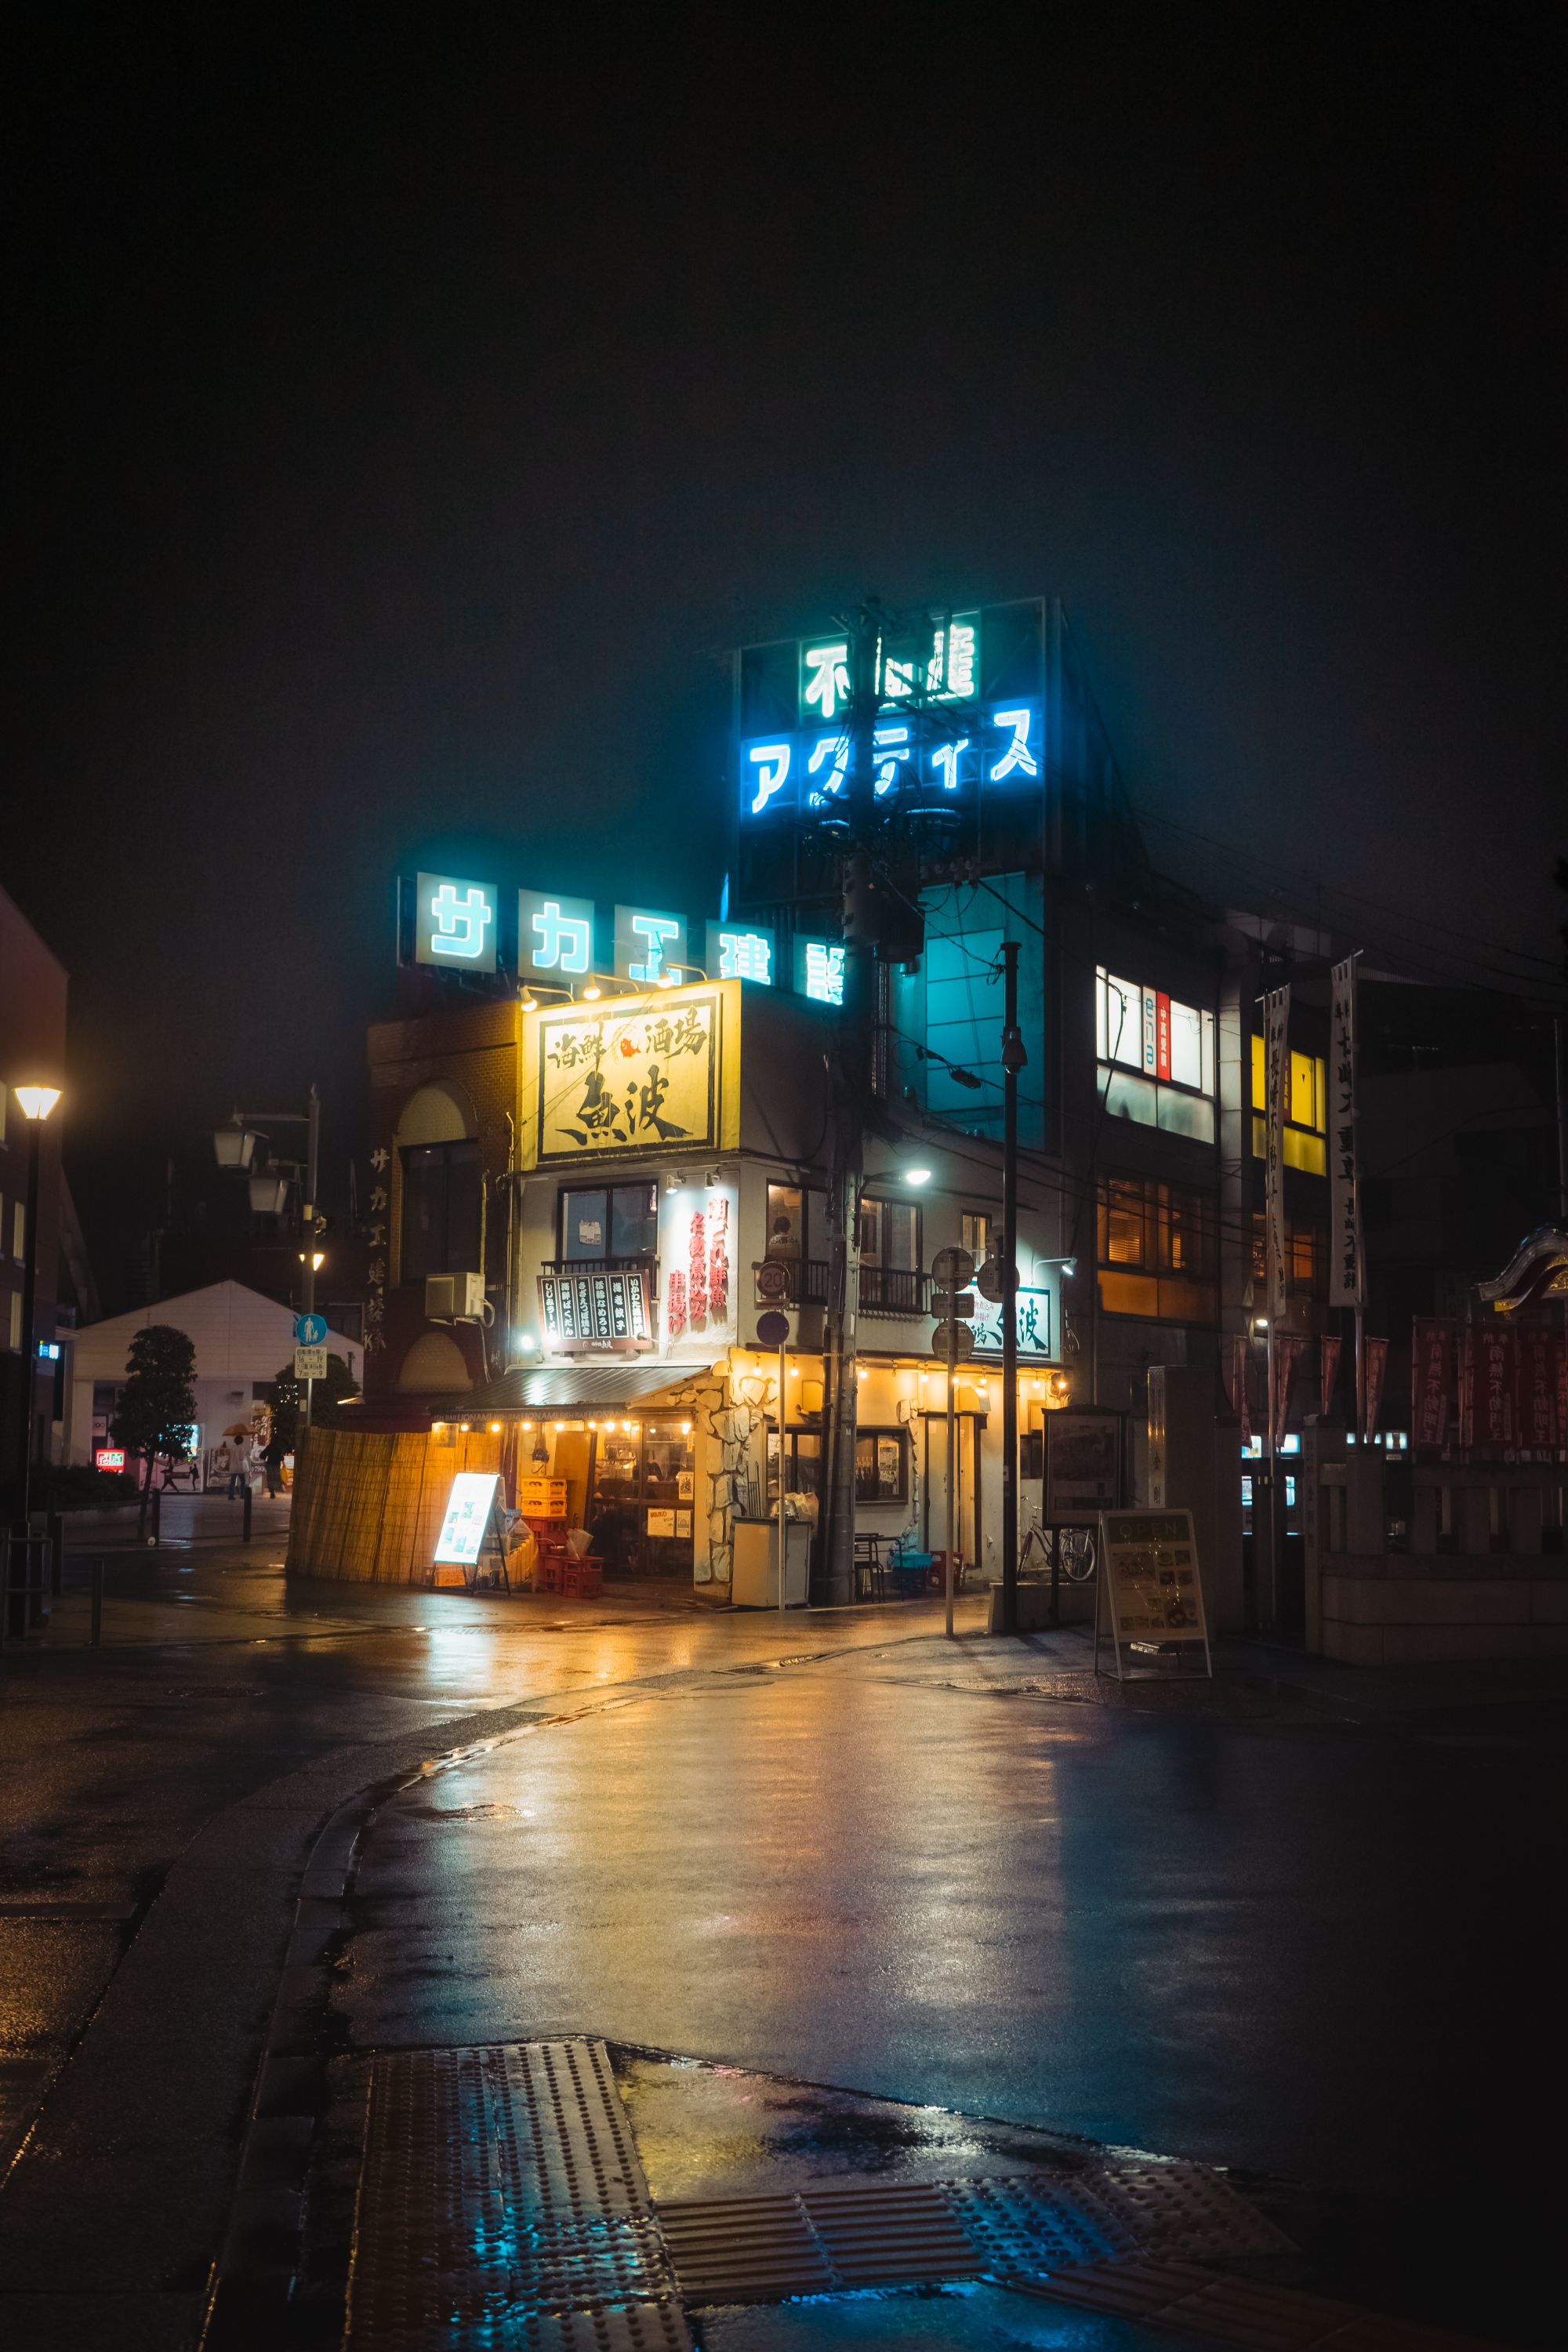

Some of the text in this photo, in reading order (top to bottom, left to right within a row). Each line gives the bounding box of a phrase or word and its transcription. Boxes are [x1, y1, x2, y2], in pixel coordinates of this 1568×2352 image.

[750, 709, 1038, 815] アクティス
[546, 1004, 708, 1071] 海鮮 酒場
[554, 1064, 694, 1145] 魚波
[688, 1210, 708, 1323] 名物煮込み
[764, 1272, 782, 1287] 20
[667, 1269, 688, 1337] 串揚げ
[1120, 1523, 1177, 1537] OPEN
